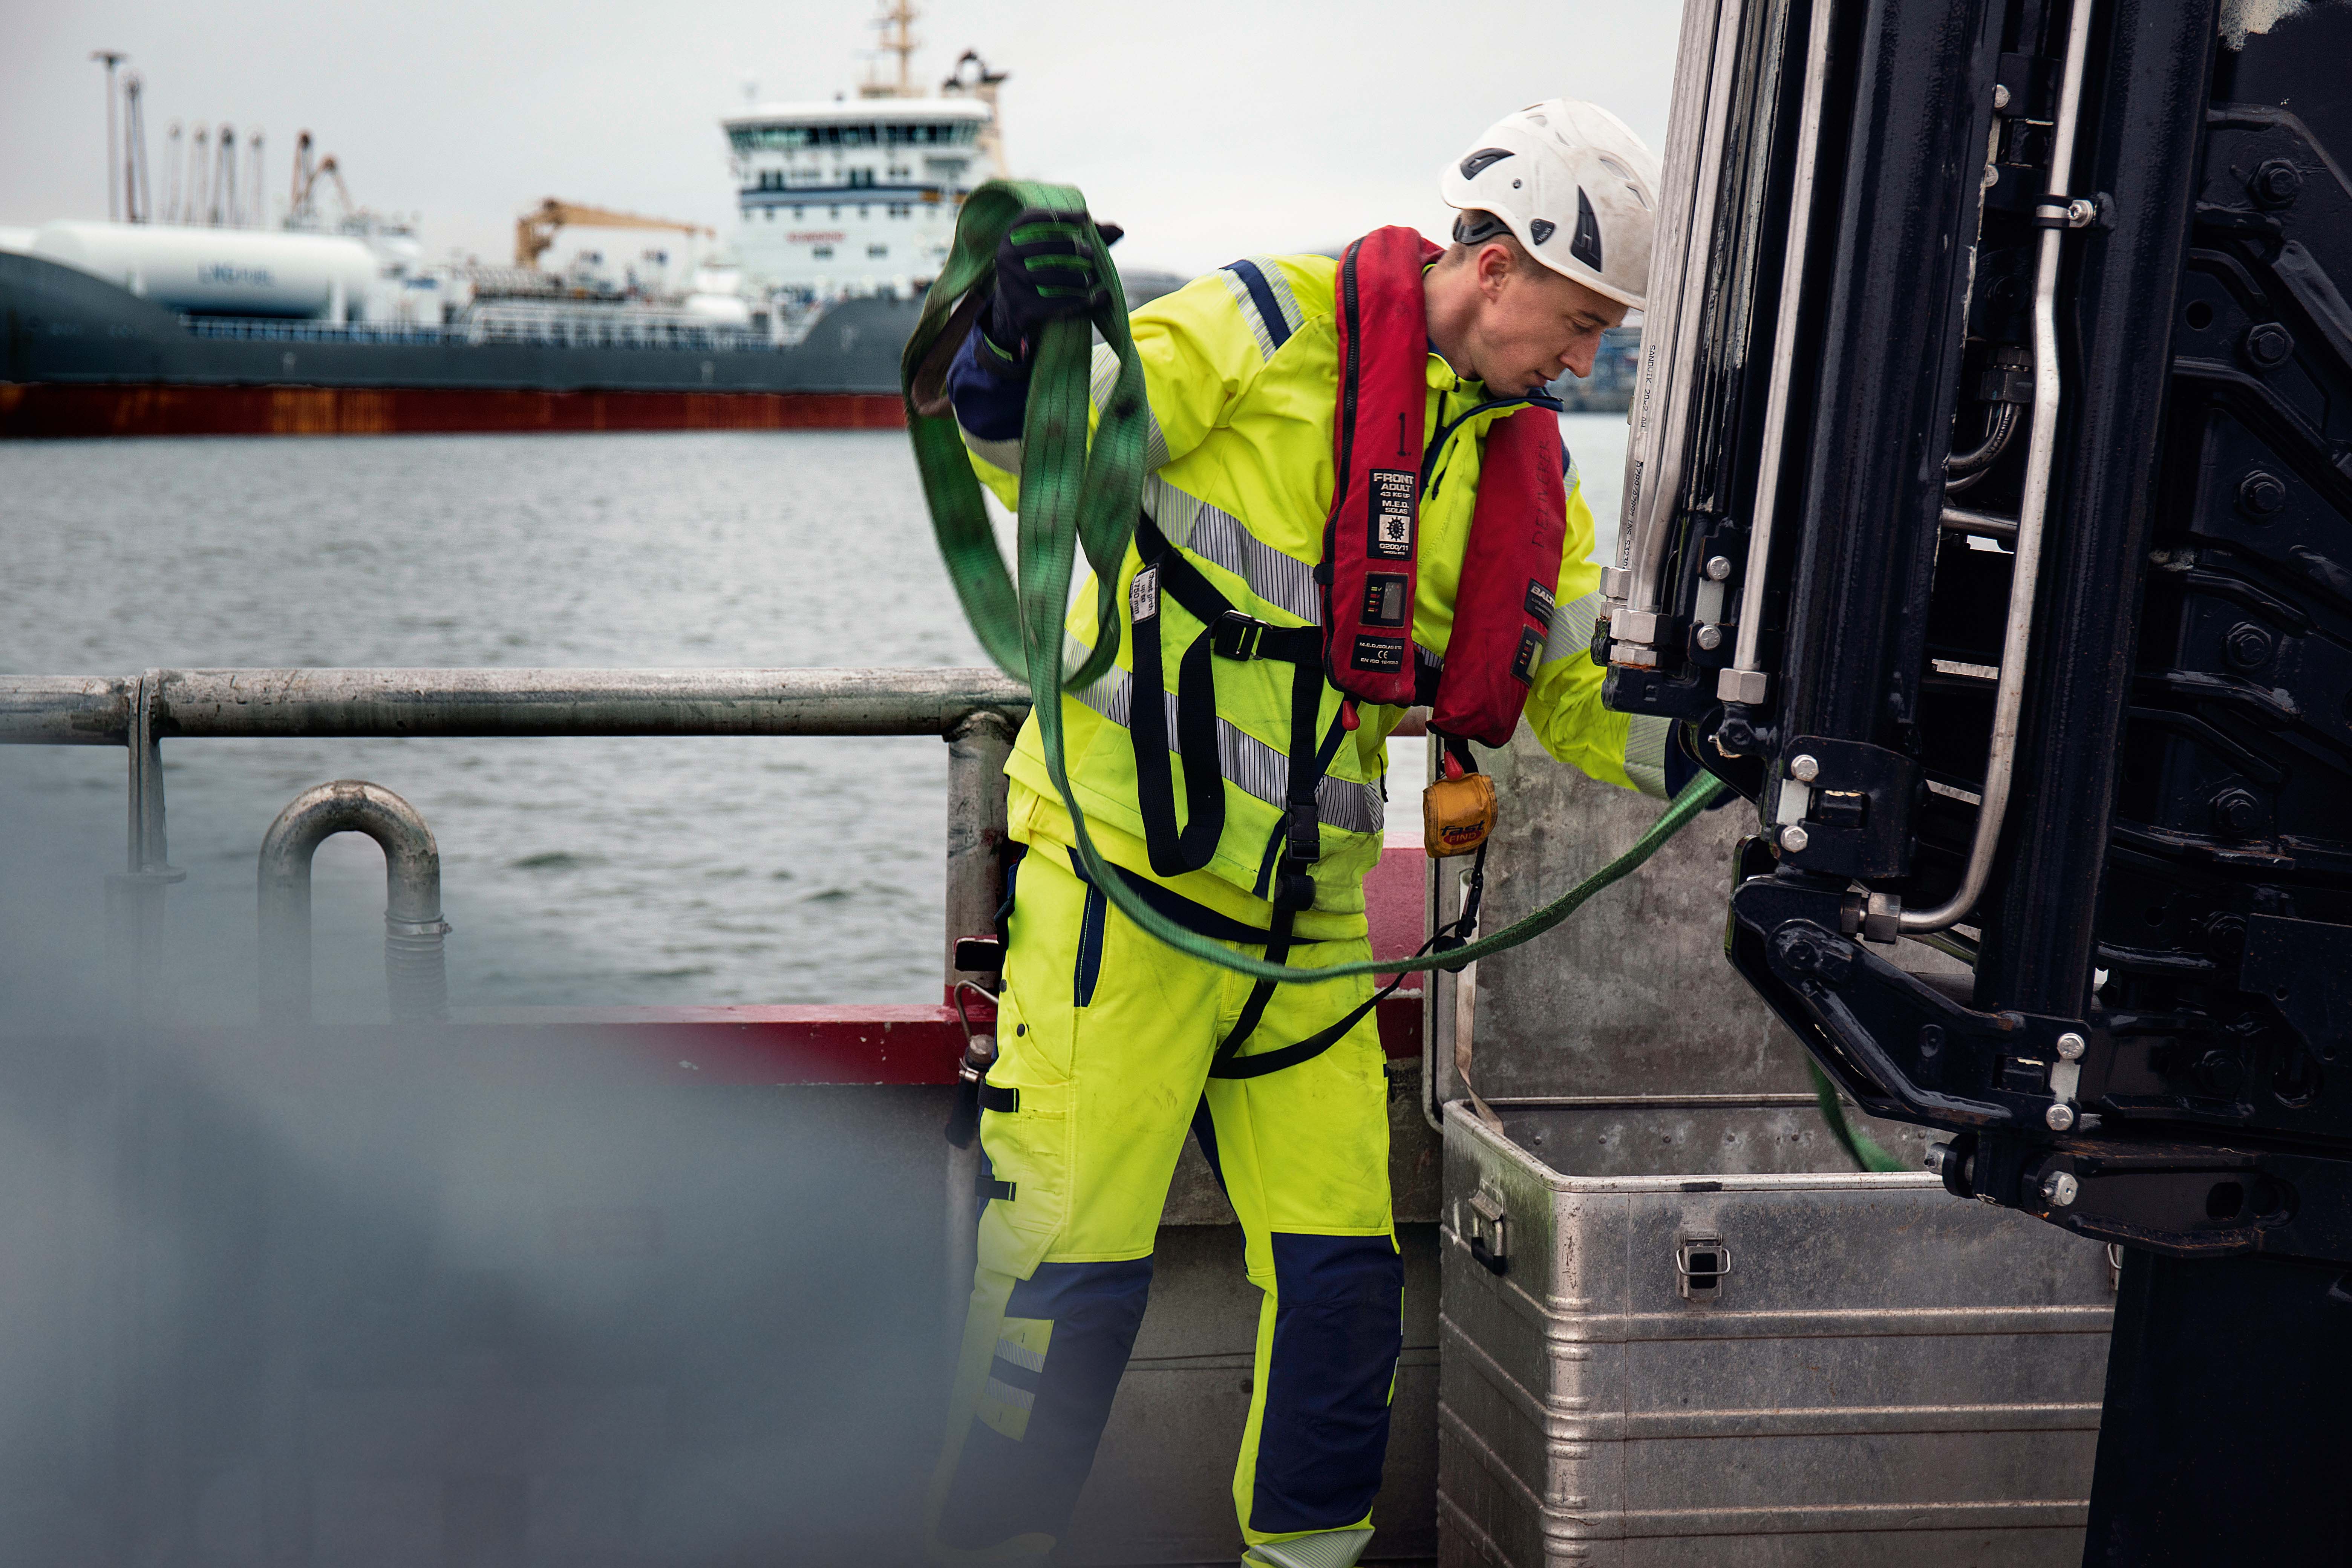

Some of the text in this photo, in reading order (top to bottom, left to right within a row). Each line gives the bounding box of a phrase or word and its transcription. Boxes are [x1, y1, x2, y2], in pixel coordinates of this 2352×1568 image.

[1646, 345, 1655, 383] SANDVIK
[1641, 417, 1647, 427] AW
[1373, 473, 1414, 484] FRONT
[1381, 483, 1411, 492] ADULT
[1140, 585, 1146, 603] up to
[1134, 601, 1139, 615] mm
[1378, 651, 1389, 659] CE
[1441, 820, 1485, 836] fast
[1449, 832, 1477, 842] FIND
